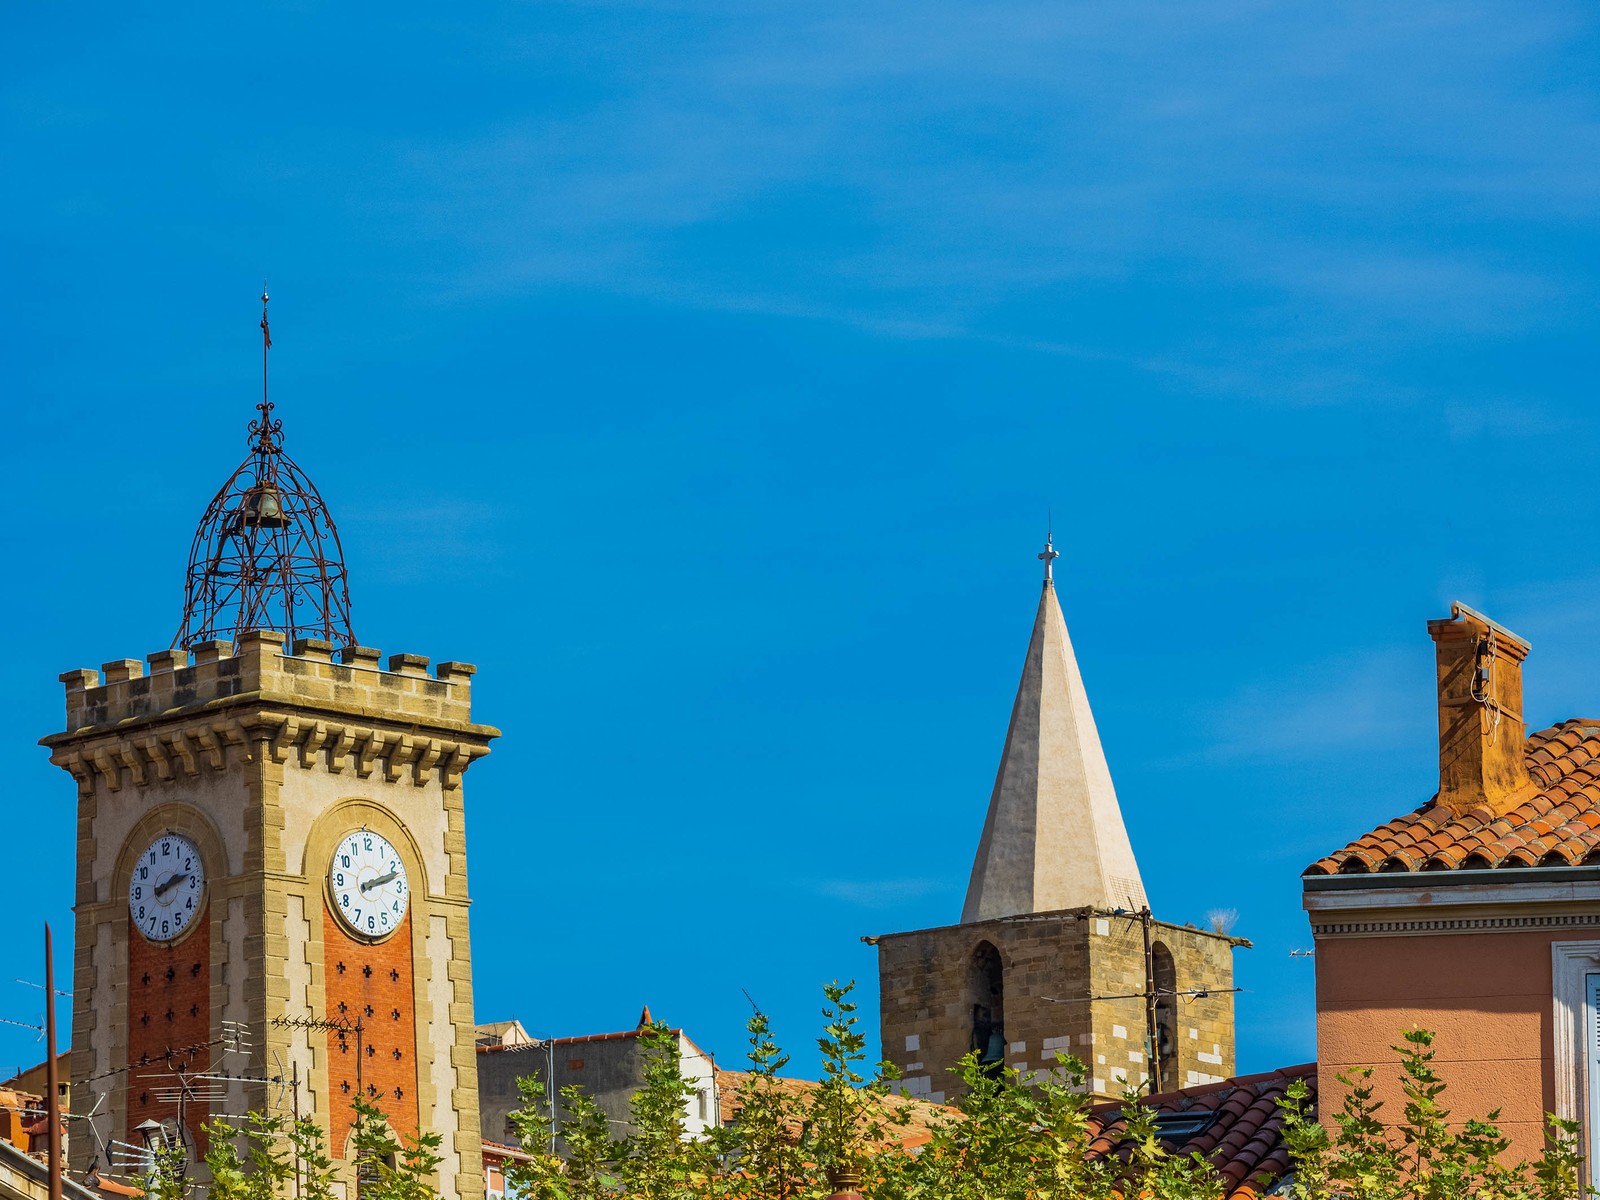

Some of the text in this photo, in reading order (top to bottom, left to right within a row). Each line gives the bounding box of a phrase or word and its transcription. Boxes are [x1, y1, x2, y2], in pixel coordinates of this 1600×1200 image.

[162, 842, 170, 856] 12
[351, 843, 358, 856] 11
[363, 838, 373, 851] 12
[150, 851, 156, 865] 11
[176, 846, 180, 859] 1
[380, 846, 384, 859] 1
[185, 858, 191, 871] 2
[341, 855, 350, 868] 10
[390, 861, 396, 873] 2
[140, 867, 148, 880] 10
[337, 873, 344, 886] 9
[190, 876, 196, 888] 3
[396, 881, 402, 893] 3
[135, 887, 142, 900] 9
[186, 897, 192, 910] 4
[343, 894, 349, 907] 8
[393, 900, 399, 913] 4
[139, 906, 145, 919] 8
[175, 912, 181, 926] 5
[355, 909, 361, 922] 7
[381, 912, 387, 925] 5
[150, 917, 156, 930] 7
[162, 921, 168, 933] 6
[368, 916, 375, 929] 6
